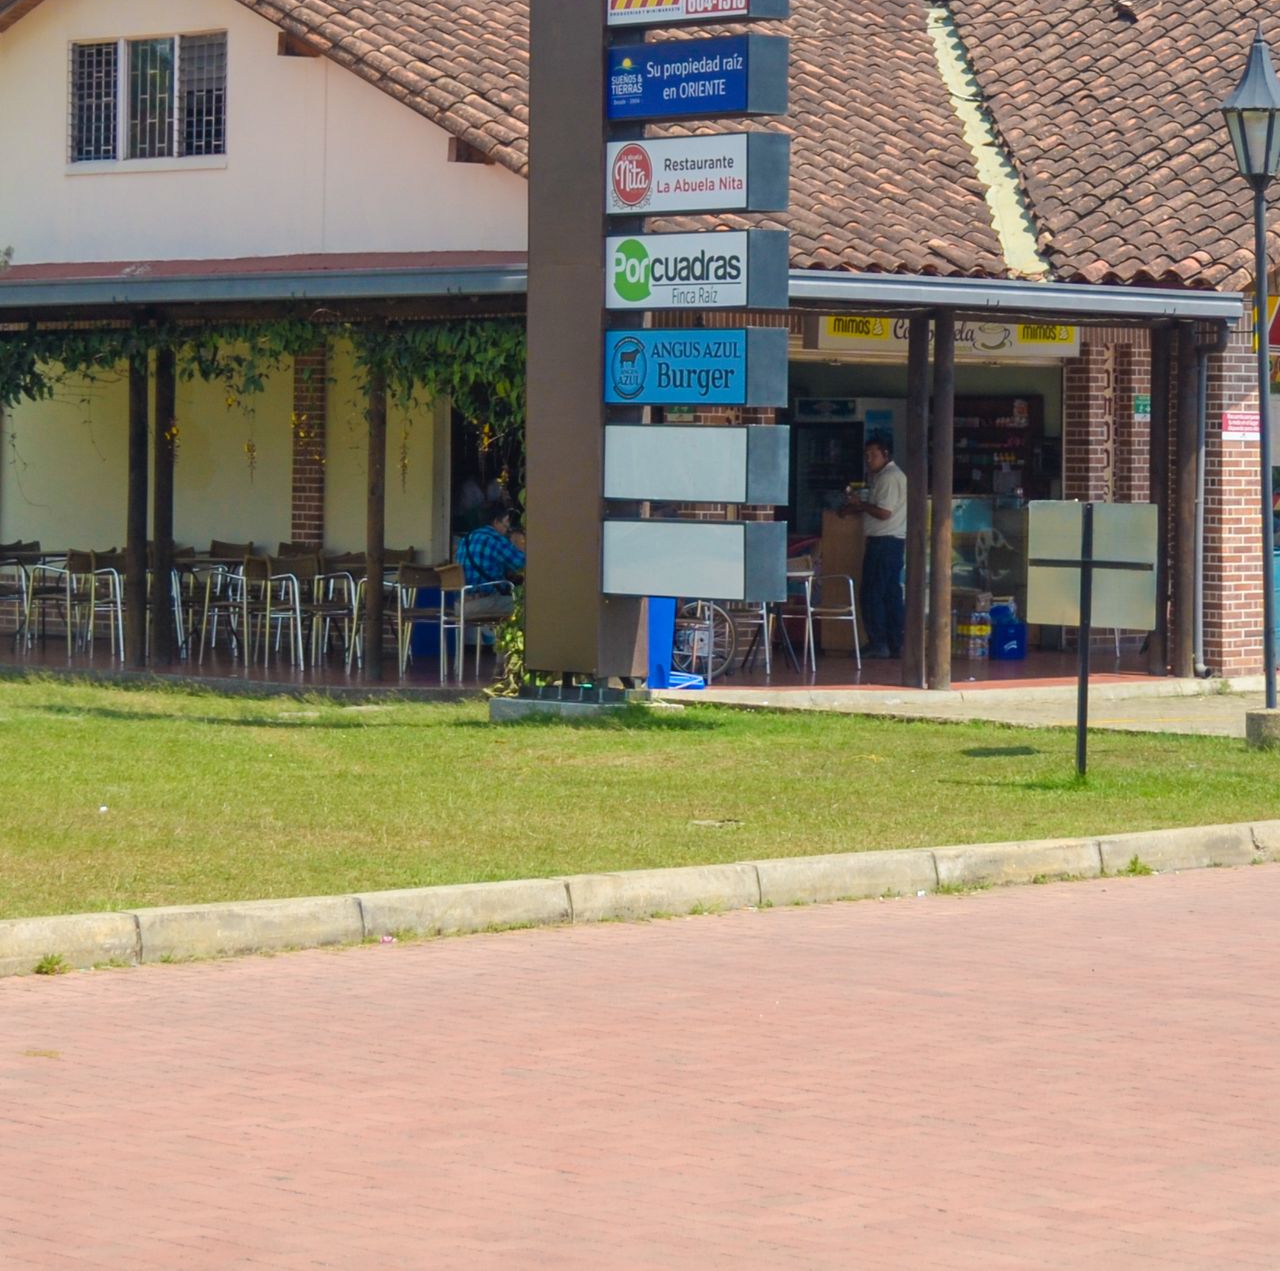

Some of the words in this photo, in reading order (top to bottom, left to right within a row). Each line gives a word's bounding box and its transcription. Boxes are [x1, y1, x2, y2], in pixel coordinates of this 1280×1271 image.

[646, 61, 661, 78] Su
[663, 56, 720, 79] propiedad
[723, 52, 743, 70] raíz
[611, 73, 637, 85] SUEÑOS
[611, 83, 643, 95] TIERRAS
[663, 86, 677, 100] en
[679, 79, 726, 99] ORIENTE
[664, 155, 734, 172] Restaurante
[615, 160, 649, 191] Nita
[657, 180, 670, 194] La
[674, 177, 716, 193] Abuela
[719, 176, 743, 191] Nita
[672, 287, 696, 304] Finca
[698, 285, 718, 304] Raíz
[651, 341, 700, 359] ANGUS
[703, 341, 741, 359] AZUL
[618, 375, 640, 386] AZUL
[657, 362, 735, 396] Burger
